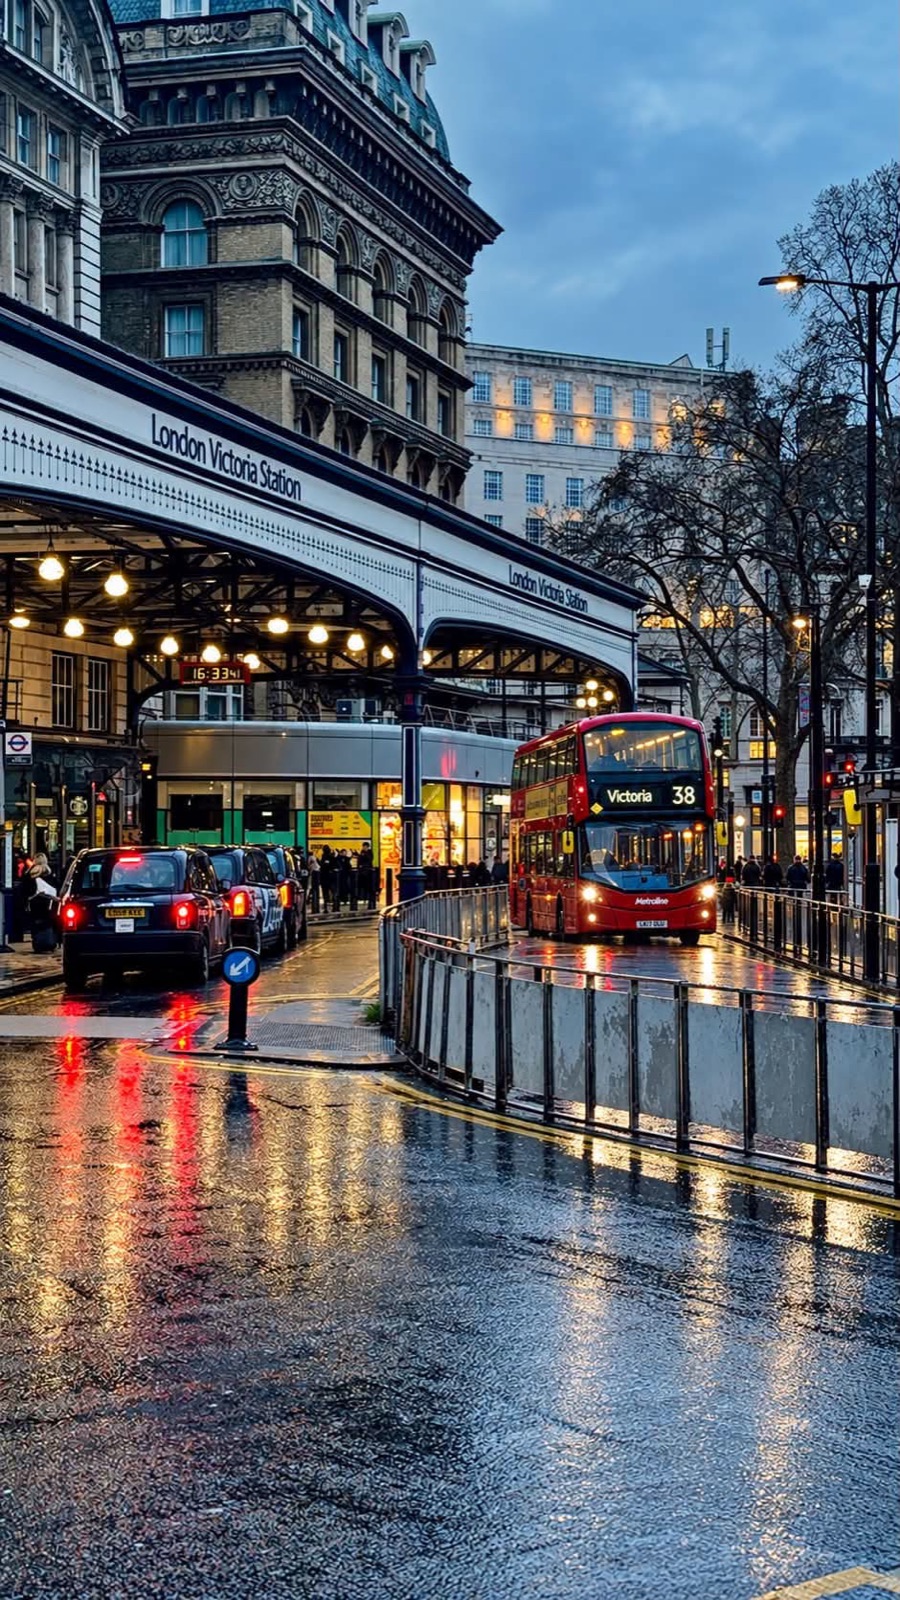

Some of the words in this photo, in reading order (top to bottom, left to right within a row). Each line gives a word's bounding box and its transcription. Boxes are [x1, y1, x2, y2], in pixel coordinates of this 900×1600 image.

[152, 413, 206, 464] London
[209, 438, 258, 485] Victoria
[260, 460, 301, 501] Station
[509, 564, 537, 593] London
[538, 576, 564, 604] Victoria
[565, 588, 588, 613] Station
[607, 789, 653, 803] Victoria
[672, 785, 695, 805] 38
[634, 896, 669, 905] Metroline
